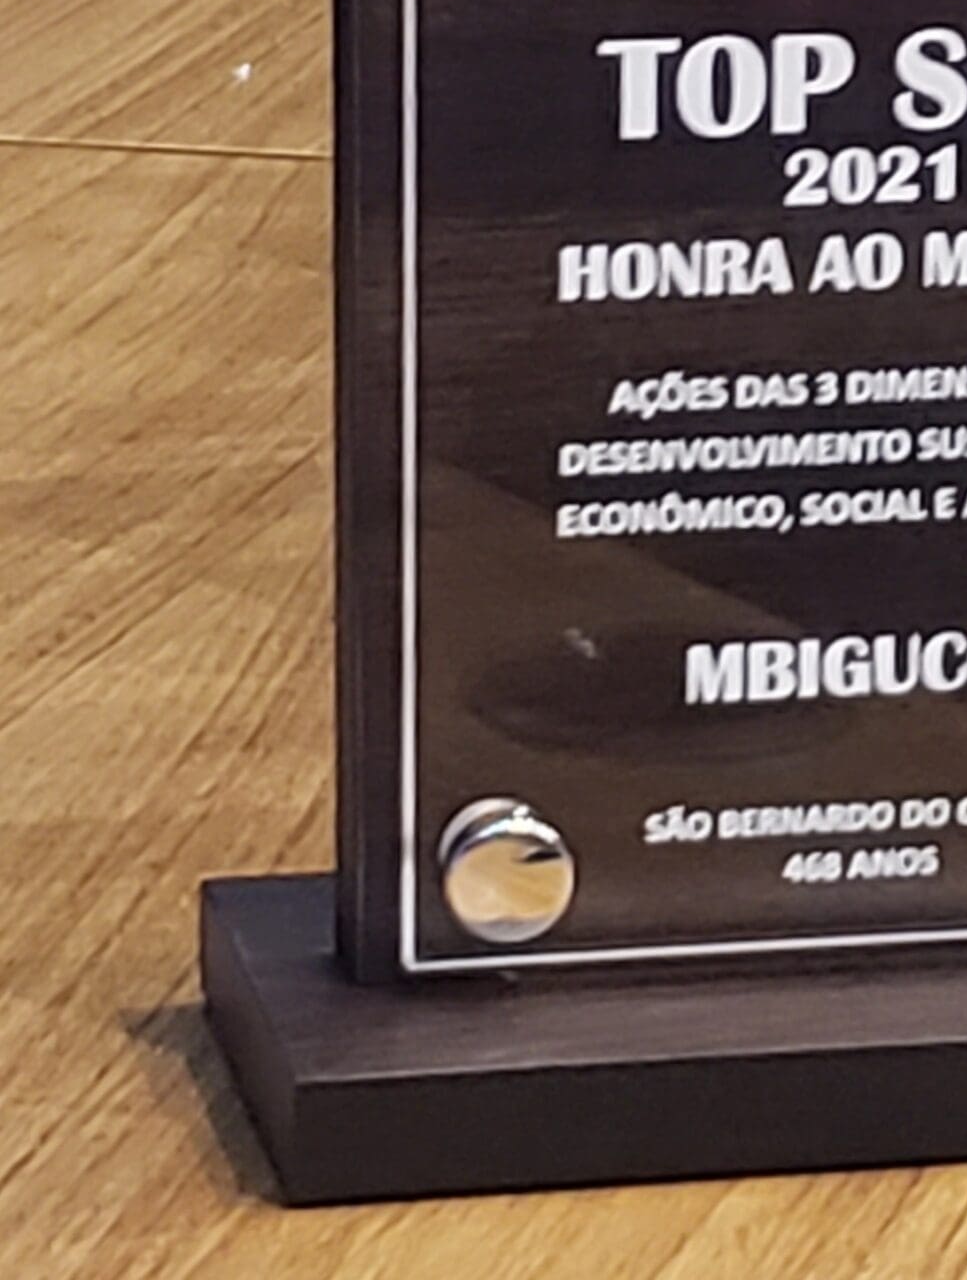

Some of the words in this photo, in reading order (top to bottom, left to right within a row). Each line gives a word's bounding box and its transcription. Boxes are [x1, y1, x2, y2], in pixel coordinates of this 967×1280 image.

[597, 32, 856, 140] TOP
[783, 144, 958, 207] 2021
[557, 237, 794, 302] HONRA
[809, 232, 903, 293] AO
[608, 370, 729, 420] AÇÕES
[735, 372, 810, 410] DAS
[814, 370, 839, 407] 3
[558, 428, 912, 477] DESENVOLVIMENTO
[556, 494, 795, 538] ECONÔMICO,
[800, 487, 928, 527] SOCIAL
[934, 486, 957, 521] E
[644, 804, 712, 844] SÃO
[718, 799, 896, 841] BERNARDO
[900, 796, 951, 829] DO
[846, 845, 940, 881] ANOS
